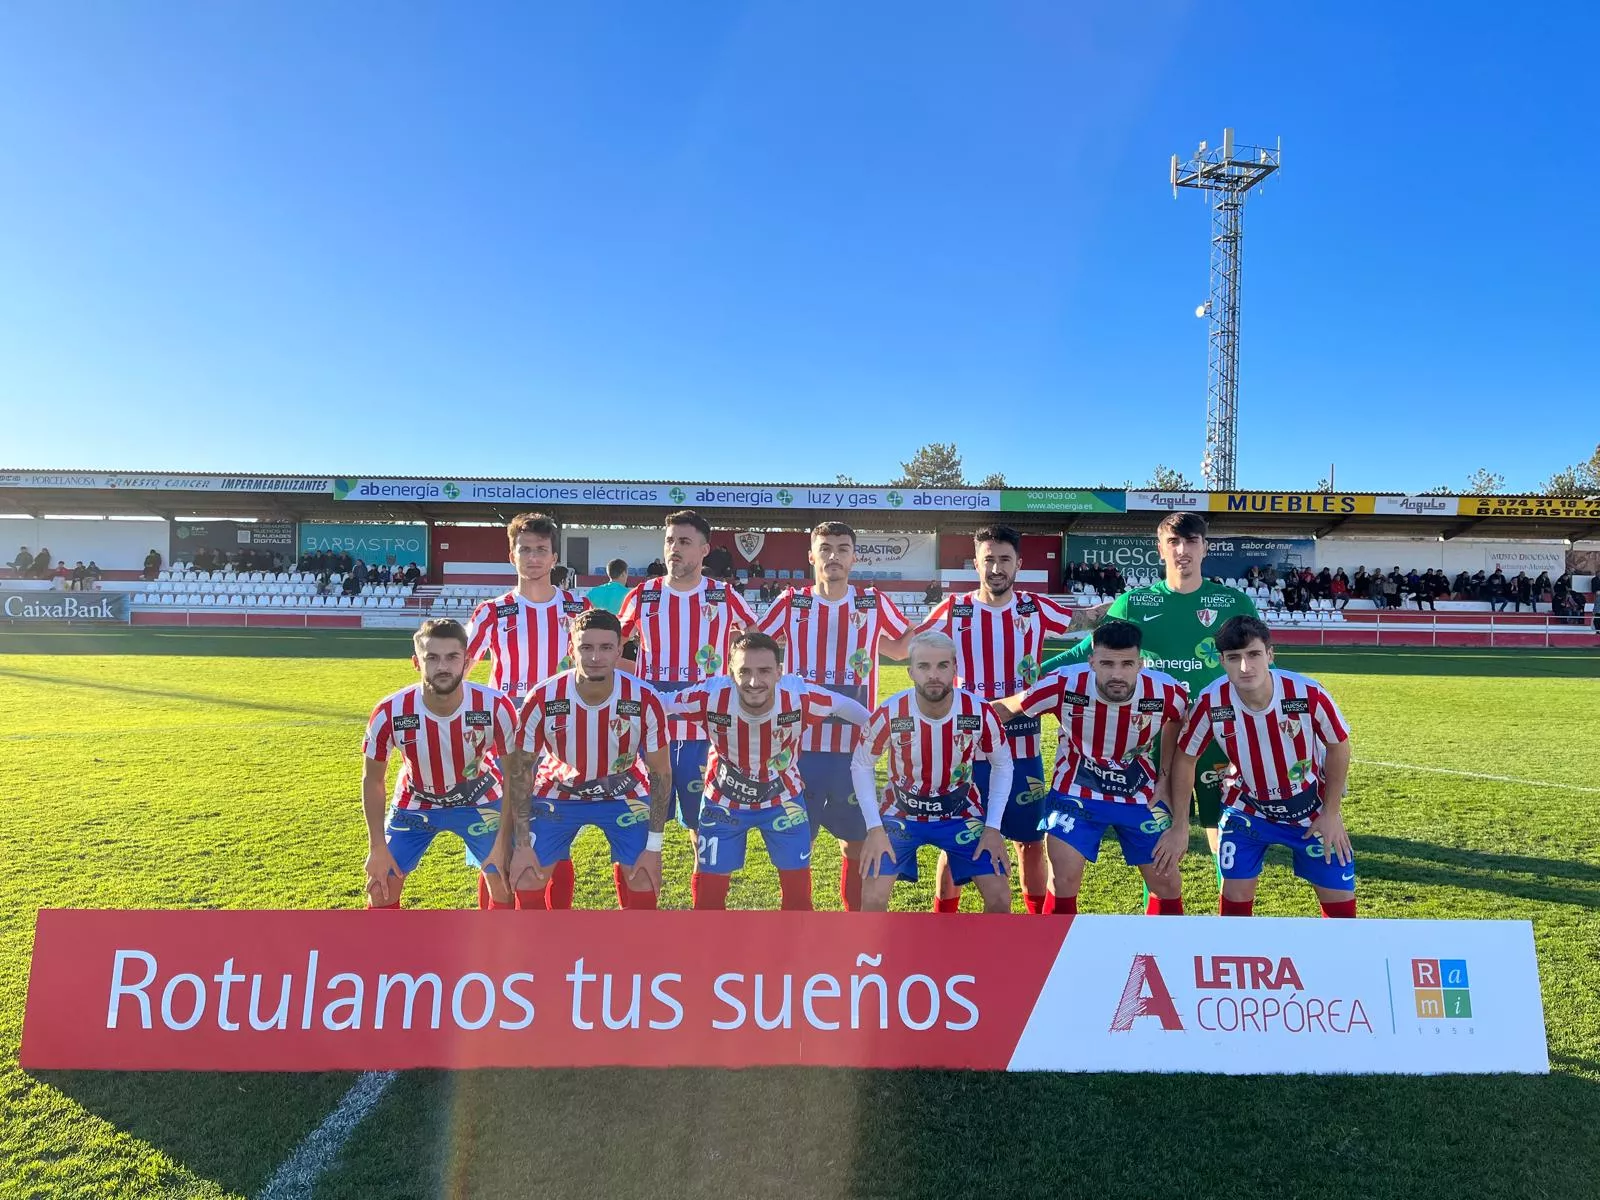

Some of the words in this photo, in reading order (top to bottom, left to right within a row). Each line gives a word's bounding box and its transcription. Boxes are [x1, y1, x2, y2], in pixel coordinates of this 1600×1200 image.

[32, 475, 96, 486] PORCELANOSA
[221, 479, 328, 491] IMPERMEABILIZANTES
[360, 481, 439, 499] abenergía
[472, 483, 578, 499] instalaciones
[583, 485, 658, 501] eléctricas
[695, 488, 773, 505] abenergía
[807, 490, 830, 505] luz
[835, 493, 844, 507] y
[848, 493, 877, 507] gas
[913, 492, 990, 508] abenergía
[1227, 495, 1355, 513] MUEBLES
[1497, 499, 1528, 507] 974
[1535, 499, 1553, 507] 31
[1559, 499, 1577, 508] 18
[1476, 507, 1600, 517] BARBASTRO
[307, 537, 420, 551] BARBASTRO
[855, 544, 902, 555] RBASTRO
[1207, 541, 1234, 551] erta
[1241, 542, 1264, 550] sabor
[1265, 542, 1275, 550] de
[4, 595, 114, 618] CaixaBank
[1005, 721, 1038, 731] CADERÍAS
[899, 792, 943, 812] Berta
[698, 835, 719, 866] 21
[1220, 840, 1237, 870] 8
[1193, 955, 1305, 991] LETRA
[106, 949, 535, 1031] Rotulamos
[566, 956, 684, 1031] tus
[712, 952, 980, 1031] sueños
[1197, 992, 1373, 1033] CORPÓREA
